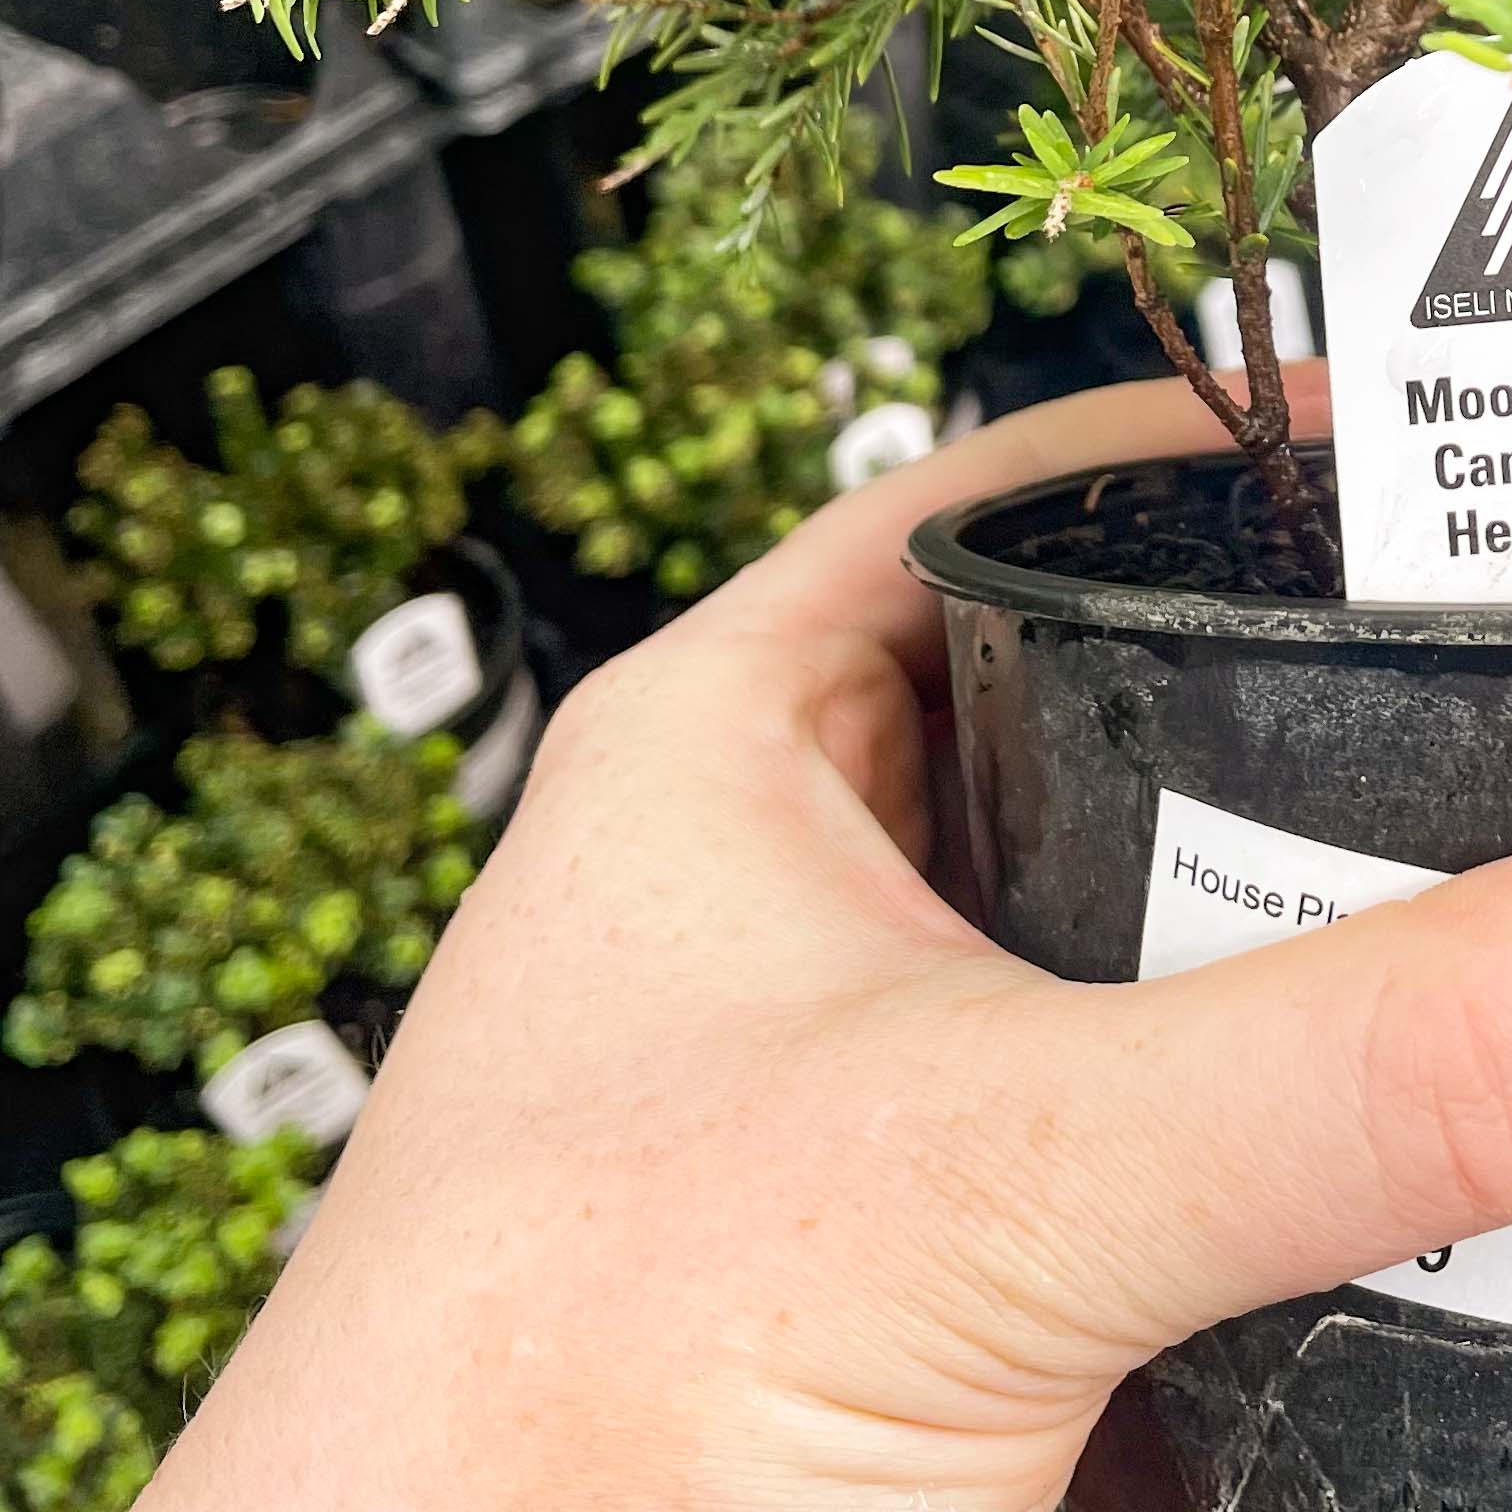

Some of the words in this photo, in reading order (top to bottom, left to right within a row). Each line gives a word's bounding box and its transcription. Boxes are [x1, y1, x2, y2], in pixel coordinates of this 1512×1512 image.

[1425, 290, 1496, 320] ISELI
[1173, 846, 1284, 918] House
[1297, 892, 1349, 925] Pl
